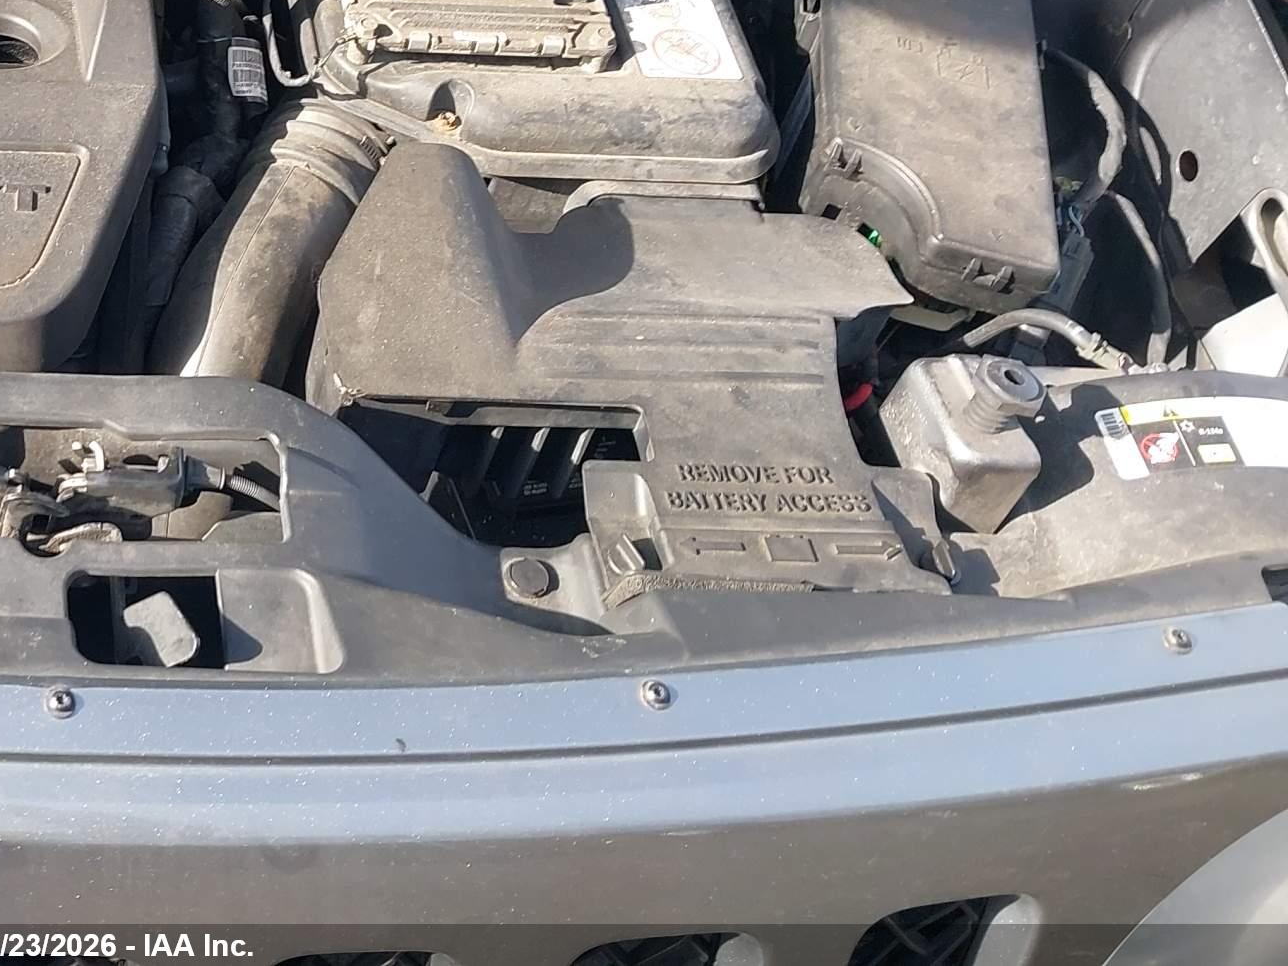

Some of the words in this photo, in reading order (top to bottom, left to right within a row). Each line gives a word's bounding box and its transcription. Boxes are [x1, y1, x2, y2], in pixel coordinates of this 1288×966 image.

[676, 464, 780, 484] REMOVE
[784, 465, 834, 485] FOR
[665, 490, 767, 513] BATTERY
[776, 492, 872, 513] ACCESS
